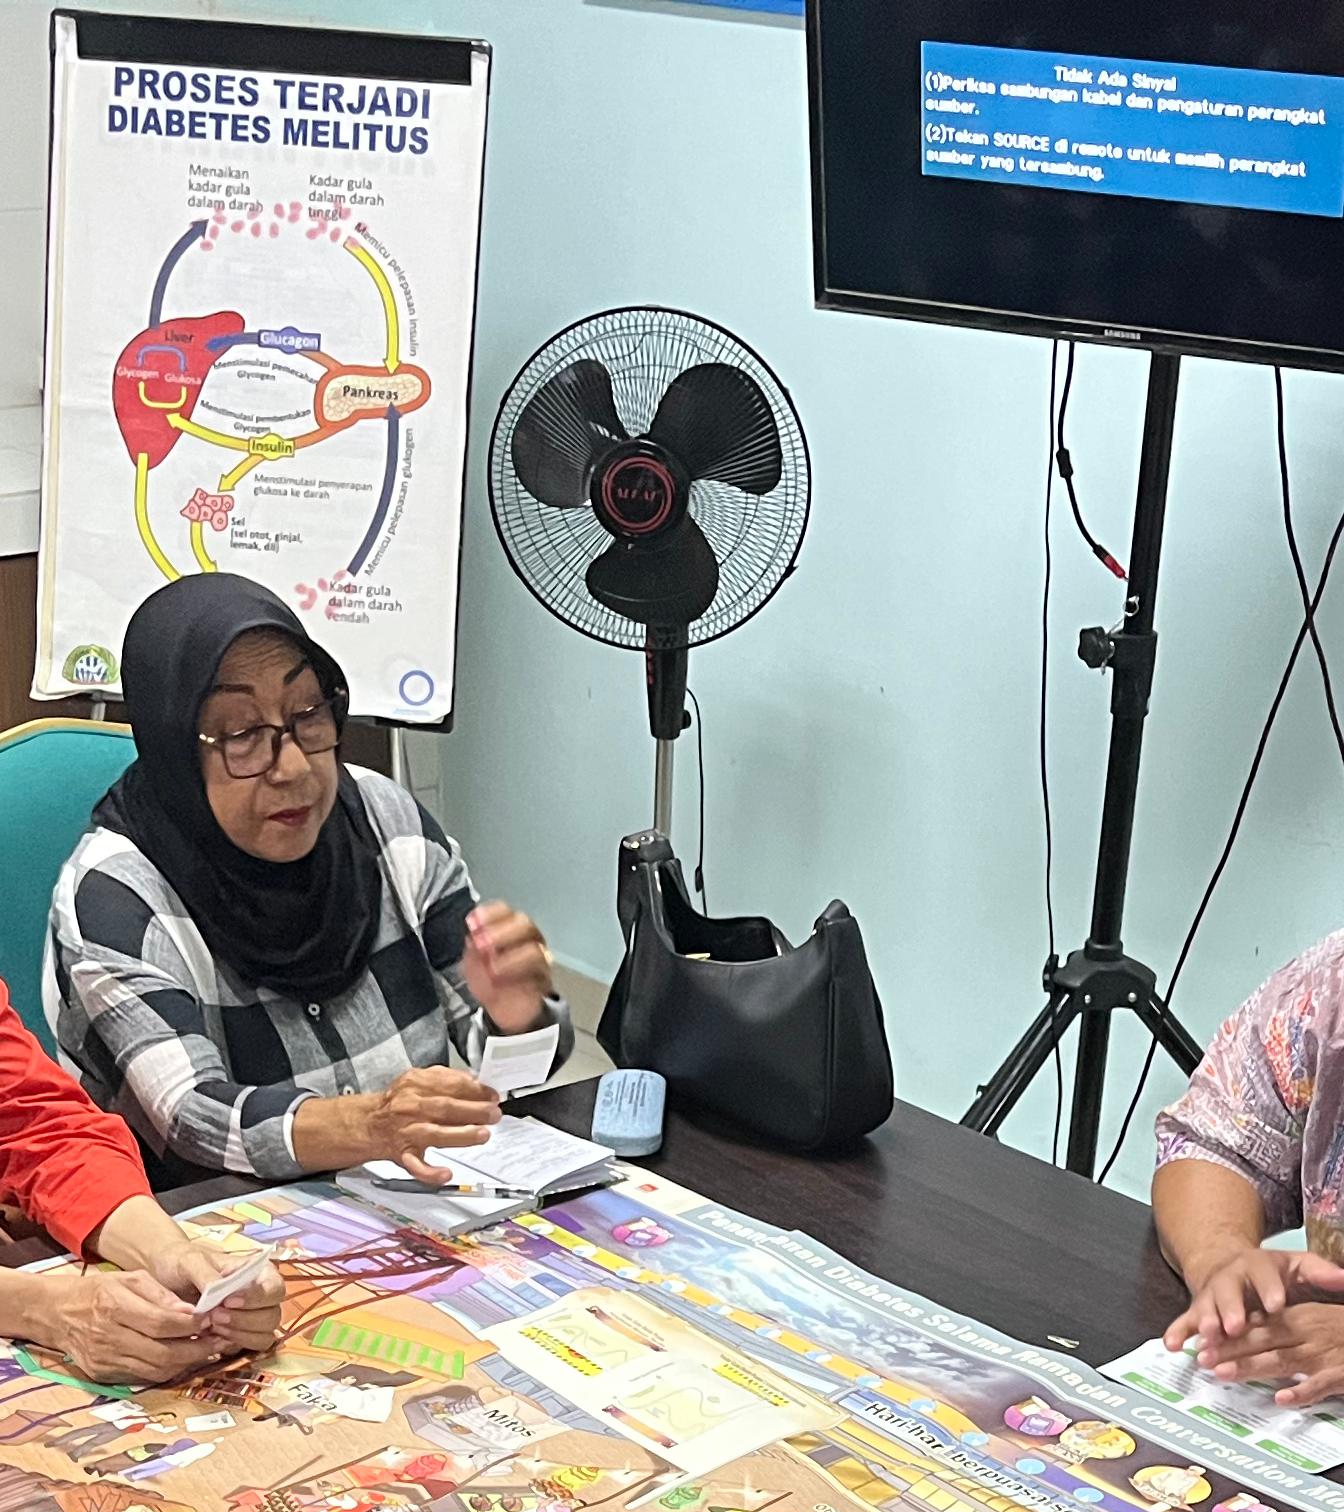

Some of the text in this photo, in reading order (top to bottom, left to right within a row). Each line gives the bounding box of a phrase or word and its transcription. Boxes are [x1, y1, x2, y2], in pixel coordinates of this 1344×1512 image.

[1054, 66, 1177, 92] Tidak Ada Sinyal
[113, 66, 431, 119] PROSES TERJADI
[1082, 88, 1122, 106] kabel
[1125, 92, 1153, 109] dan
[1157, 98, 1243, 116] pengaturan
[1247, 105, 1325, 126] perangkat
[108, 104, 429, 155] DIABETES MELITUS
[980, 154, 1015, 172] yang
[993, 132, 1050, 151] SOURCE
[1055, 139, 1068, 153] di
[1072, 142, 1122, 159] remote
[1127, 147, 1171, 164] untuk
[1229, 157, 1306, 177] perangkat
[189, 164, 249, 180] Menaikan
[188, 180, 251, 198] kadar gula
[309, 174, 373, 192] Kadar gula
[187, 196, 225, 210] dalam
[308, 190, 385, 207] dalam darah
[260, 332, 319, 350] Glucagon
[342, 385, 399, 401] Pankreas
[251, 439, 293, 454] Insulin
[290, 488, 330, 499] ke darah
[231, 516, 245, 526] Sel
[328, 581, 391, 598] Kadar gula
[328, 597, 402, 611] dalam darah
[823, 1264, 925, 1319] Diabetes
[922, 1313, 1013, 1357] Selama
[1011, 1347, 1127, 1408] Ramadan
[1130, 1404, 1303, 1488] Conversation
[482, 1407, 537, 1438] Mitos
[952, 1452, 1052, 1512] berpuasa
